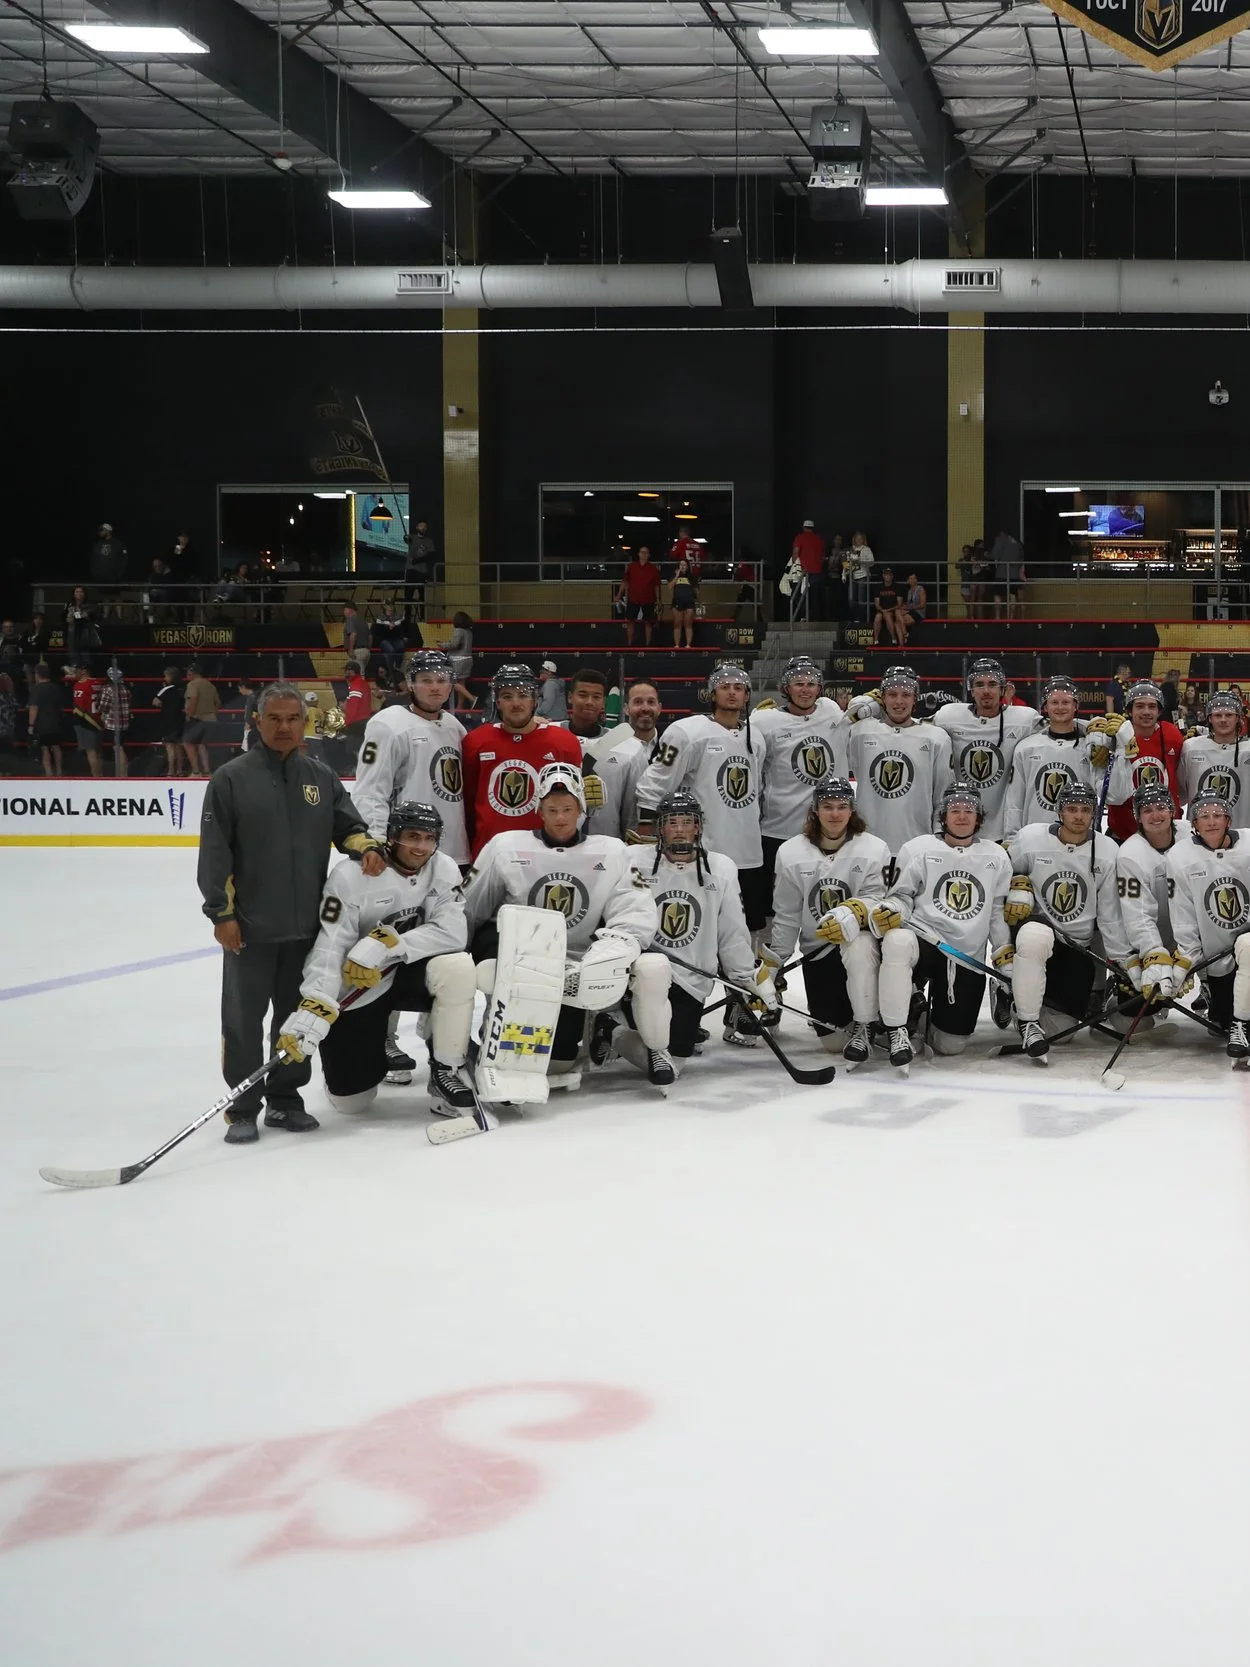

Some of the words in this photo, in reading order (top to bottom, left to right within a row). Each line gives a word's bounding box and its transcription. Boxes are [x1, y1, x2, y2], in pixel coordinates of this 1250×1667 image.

[1191, 0, 1226, 12] 2017
[153, 631, 186, 644] VEGAS
[207, 631, 233, 643] BORN
[362, 741, 378, 765] 6
[504, 761, 529, 772] VEGAS
[84, 798, 163, 816] ARENA
[547, 872, 574, 883] VEGAS
[665, 891, 692, 902] VEGAS
[321, 896, 343, 924] 8
[602, 931, 629, 943] CCM
[301, 998, 334, 1017] CM
[487, 1000, 507, 1062] CCM
